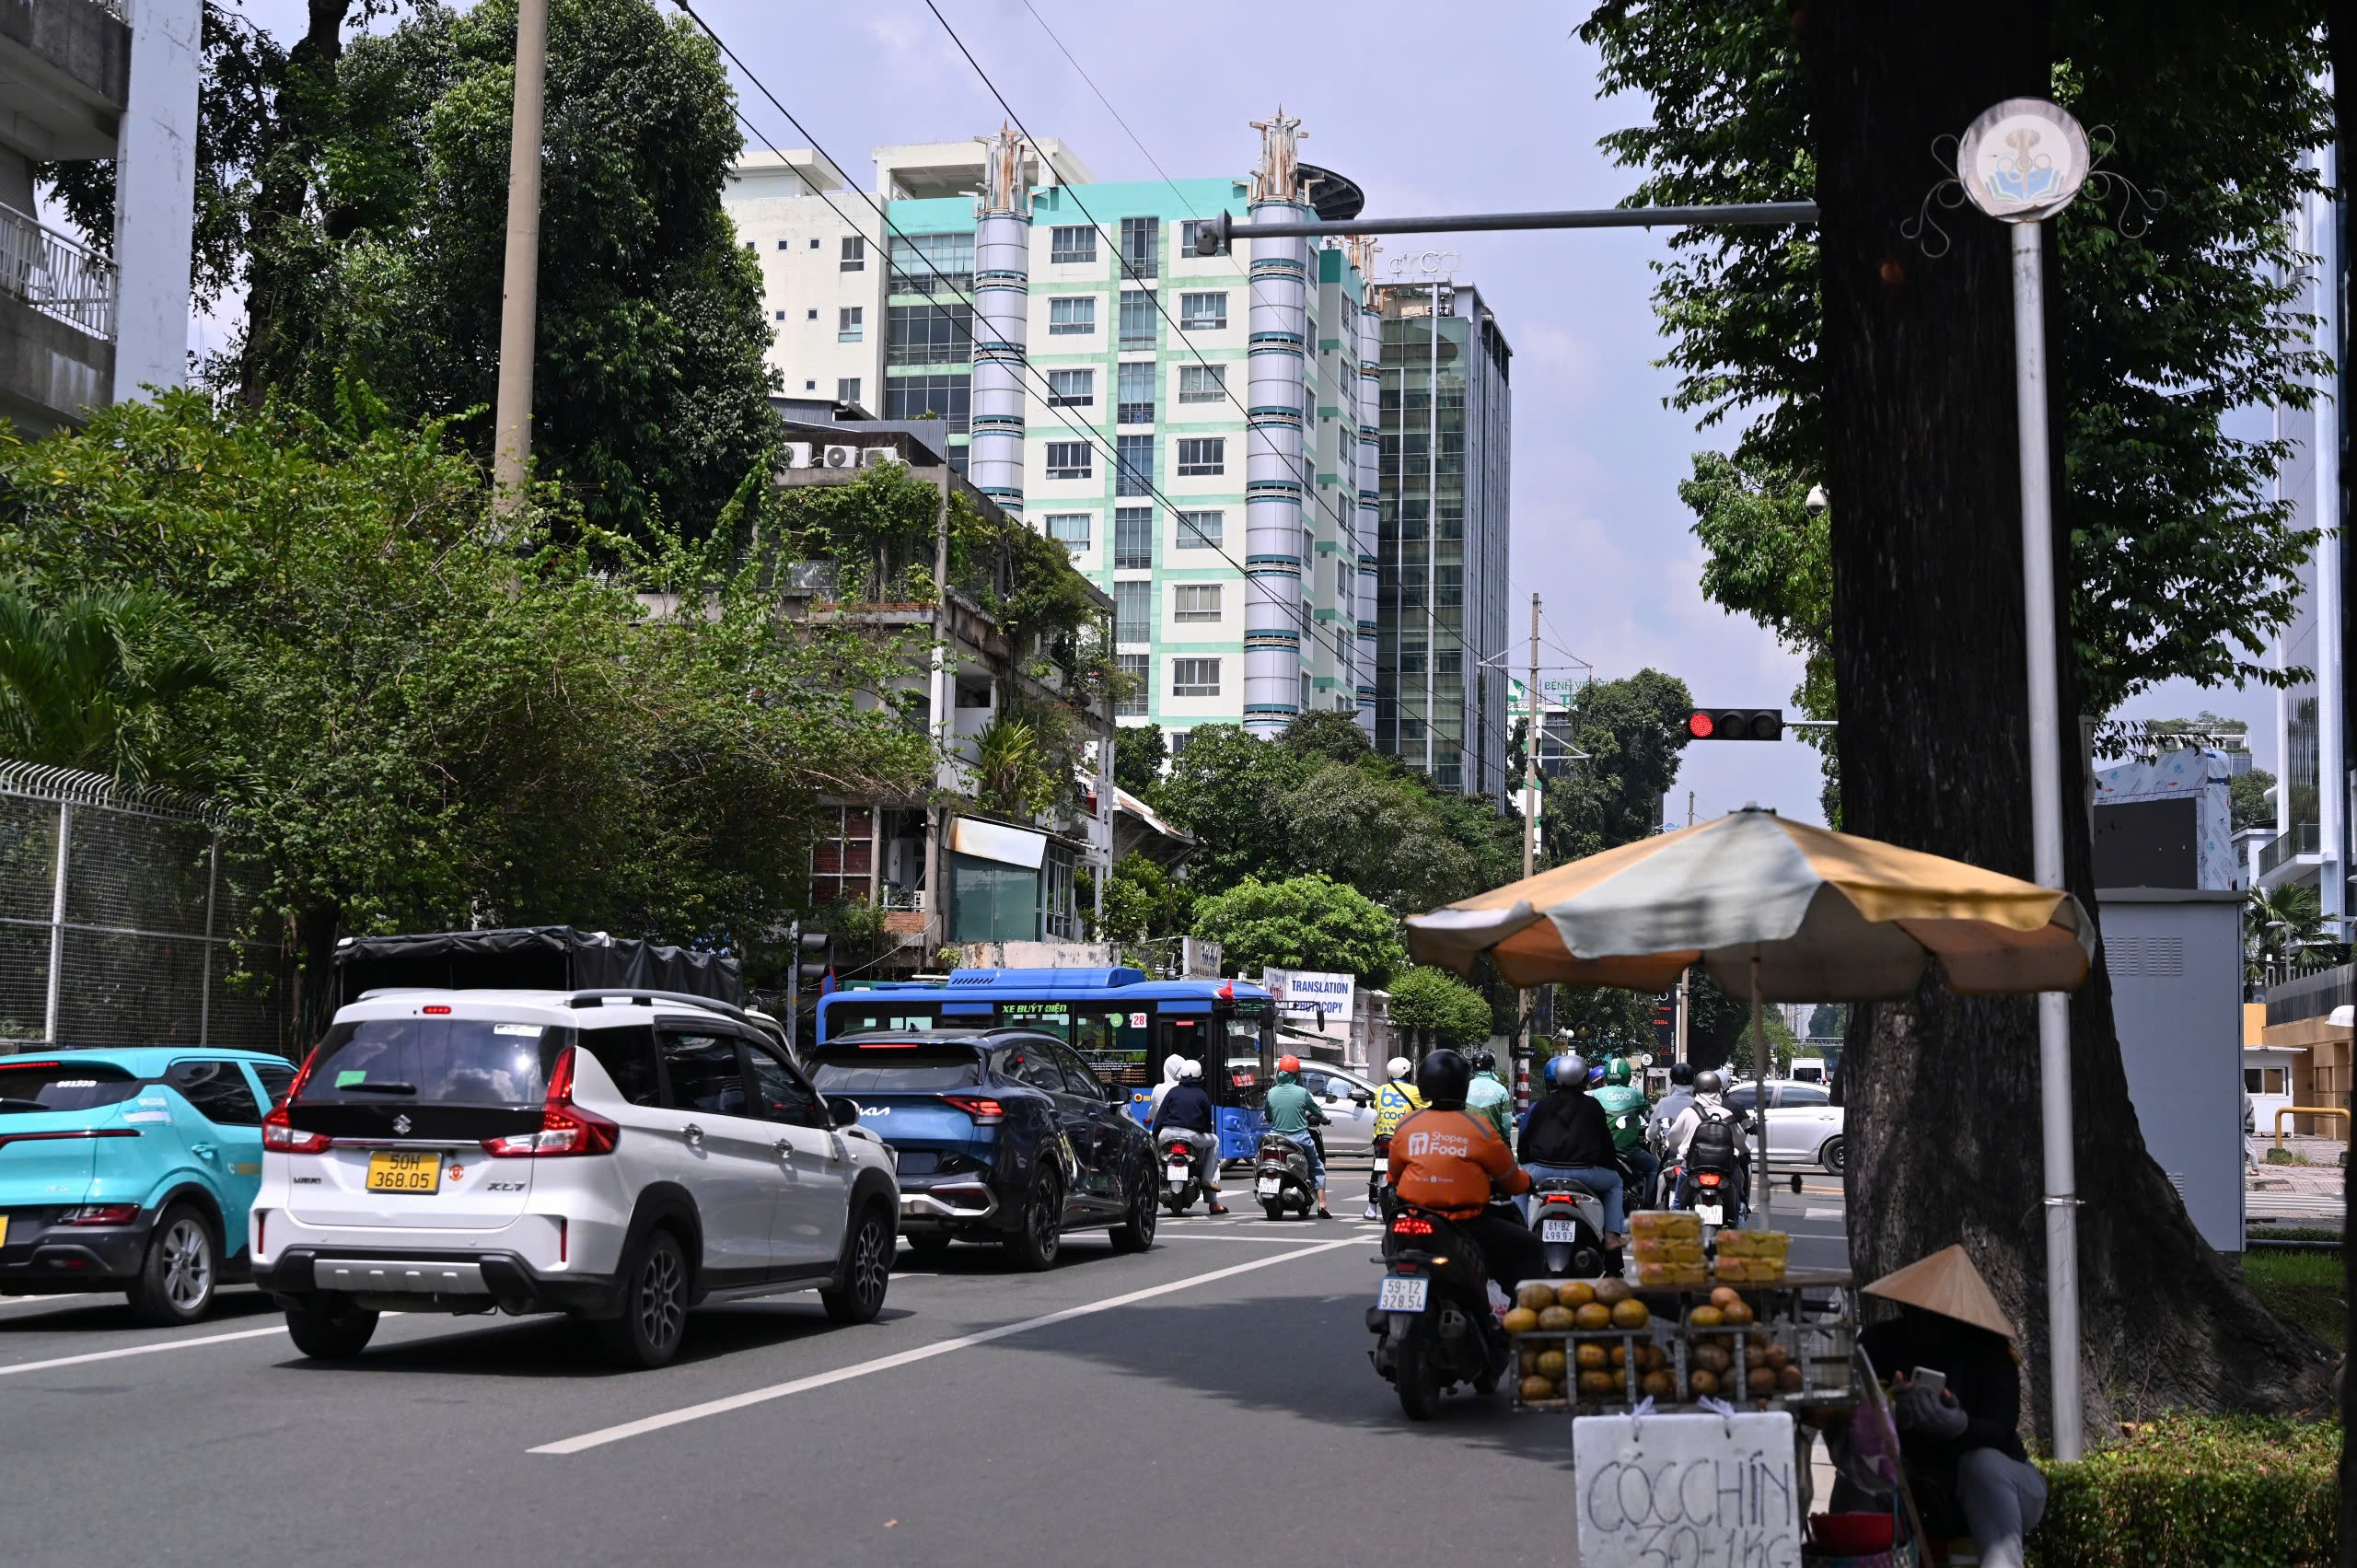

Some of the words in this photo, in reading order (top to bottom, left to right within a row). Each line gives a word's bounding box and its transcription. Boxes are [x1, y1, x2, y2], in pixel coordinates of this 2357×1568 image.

[1292, 980, 1349, 994] TRANSLATION
[1002, 1005, 1016, 1013] XE
[1016, 1003, 1044, 1013] BUÝT
[1295, 1000, 1343, 1014] PHOTCOPY
[1133, 1015, 1144, 1026] 28
[1380, 1086, 1408, 1109] be
[1606, 1091, 1631, 1101] Grab
[1431, 1132, 1469, 1144] Shopee
[1430, 1142, 1468, 1157] Food
[390, 1153, 420, 1170] 50H
[375, 1172, 430, 1188] 368.05
[487, 1182, 526, 1191] XL7
[1387, 1281, 1421, 1295] 59-T2
[1382, 1295, 1422, 1308] 328.54
